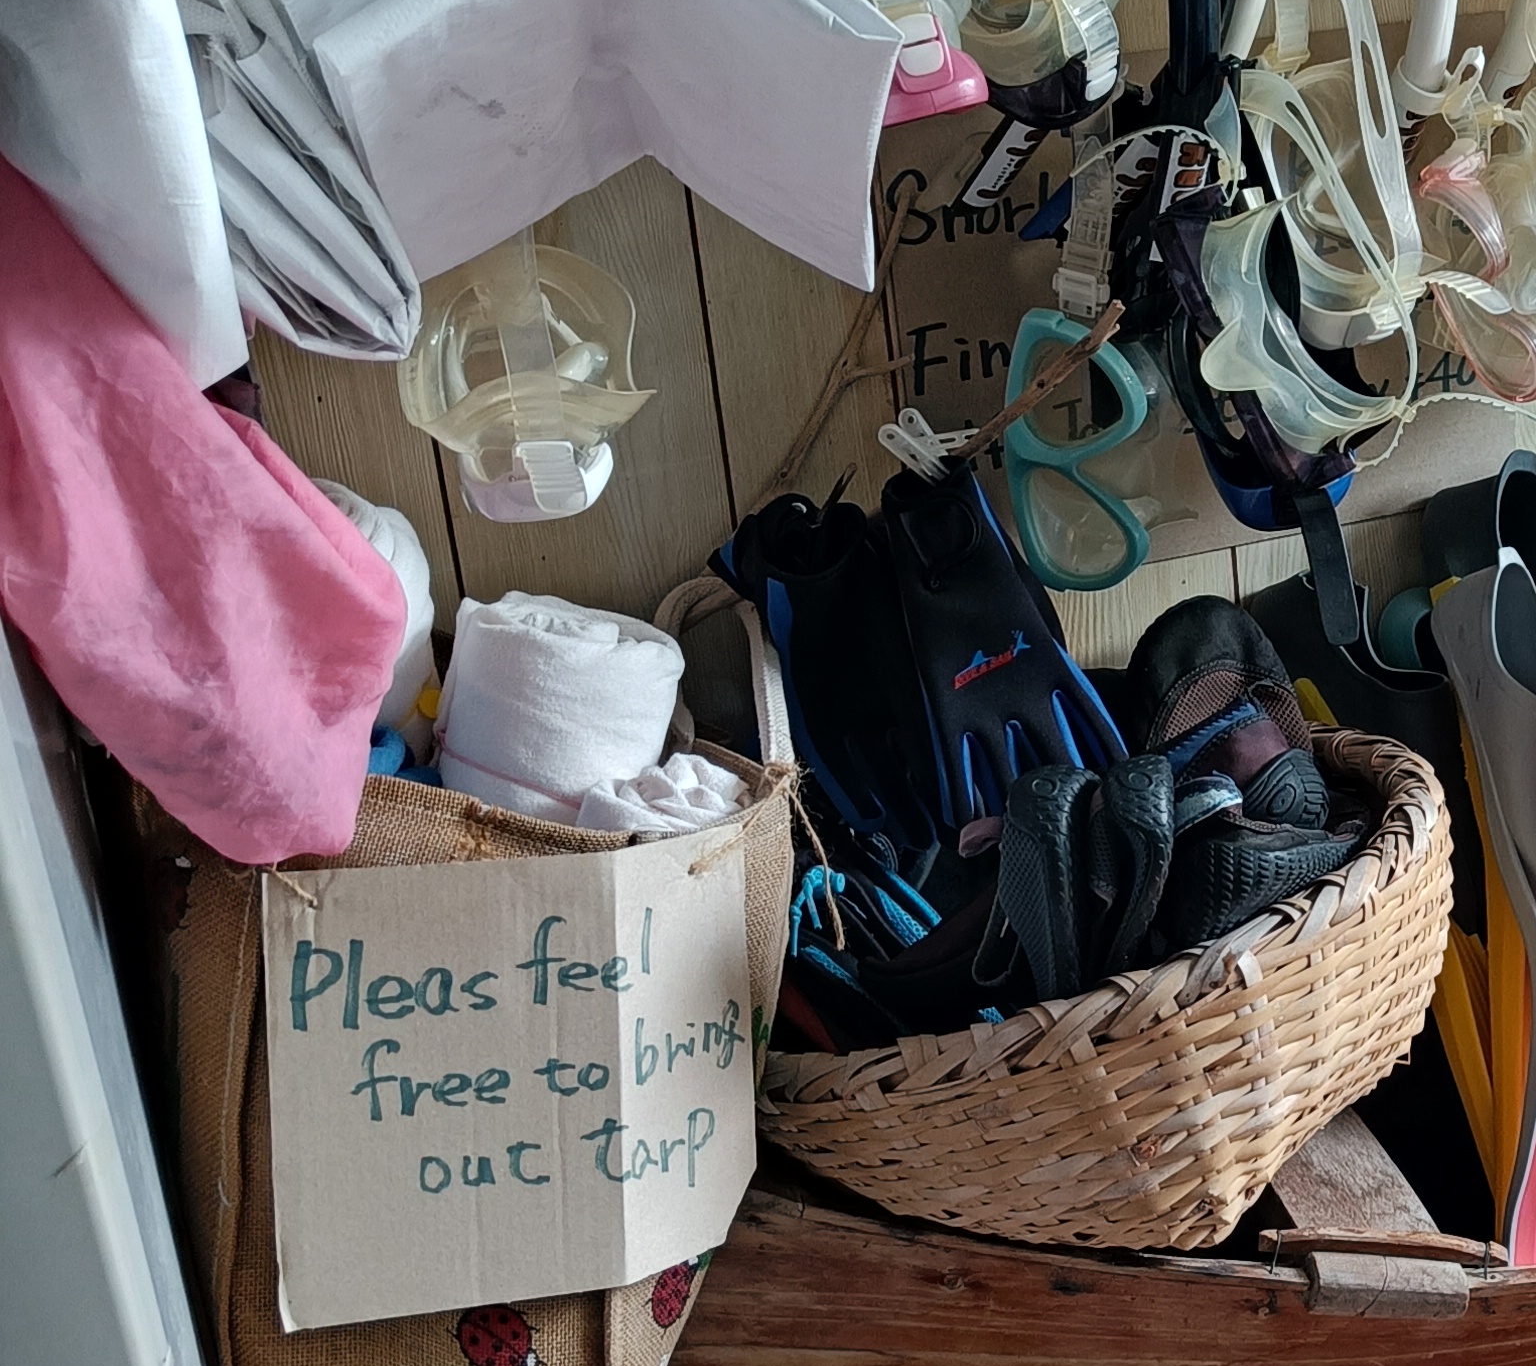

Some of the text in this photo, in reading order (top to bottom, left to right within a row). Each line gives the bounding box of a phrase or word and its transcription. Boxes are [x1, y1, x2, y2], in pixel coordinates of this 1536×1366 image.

[288, 906, 654, 1032] Pleas feel
[351, 1039, 512, 1122] free
[533, 1057, 610, 1097] to
[419, 1107, 716, 1195] out tarp
